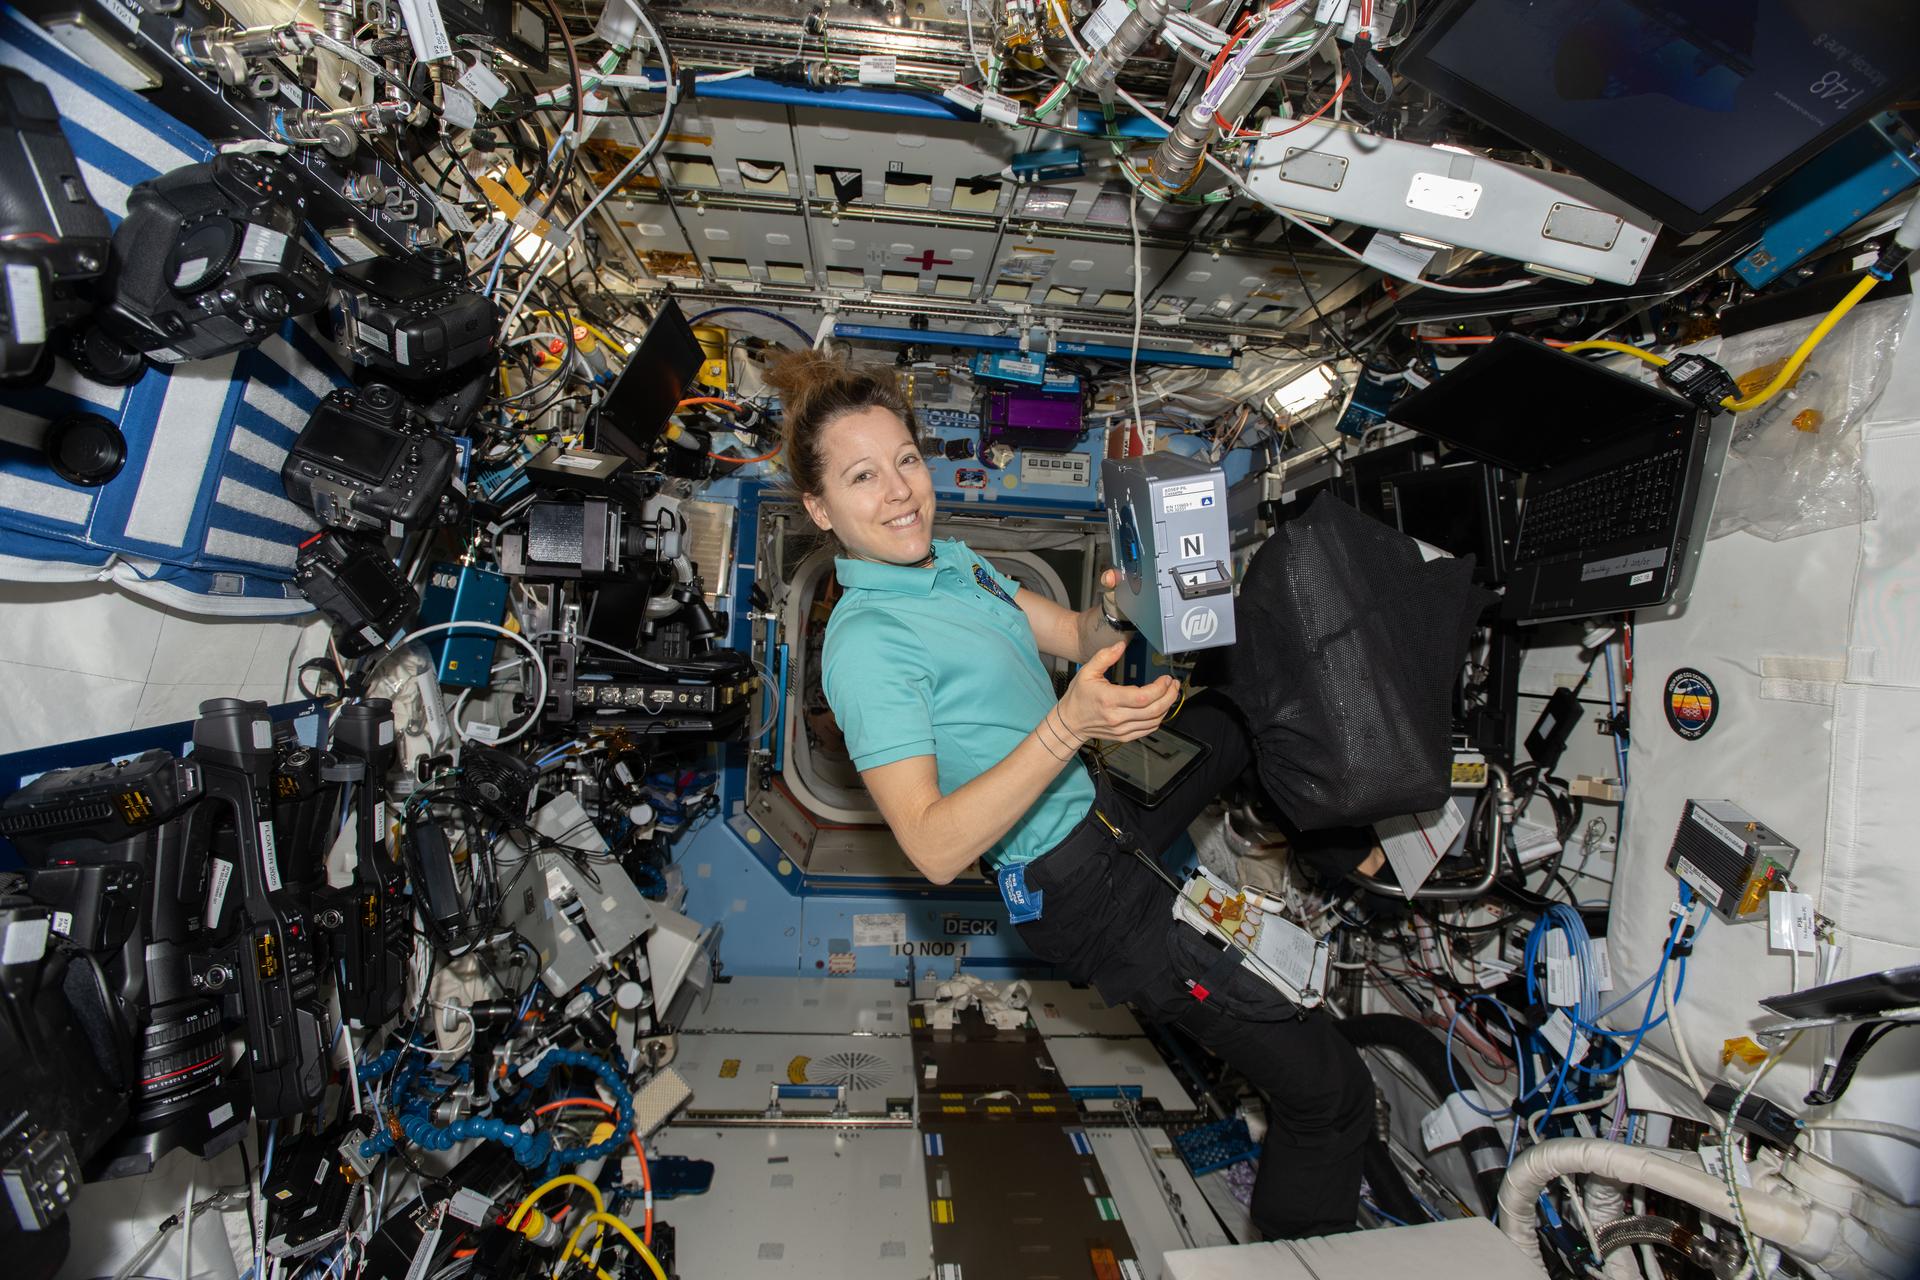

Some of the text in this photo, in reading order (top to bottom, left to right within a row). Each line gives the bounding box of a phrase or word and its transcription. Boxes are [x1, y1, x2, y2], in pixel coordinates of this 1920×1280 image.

[1809, 71, 1864, 110] 1:48
[314, 155, 327, 168] OFF
[396, 177, 421, 201] 120 VDC
[381, 212, 393, 224] OFF
[254, 229, 272, 260] Nikon
[928, 410, 980, 428] OVHD
[1184, 536, 1200, 557] N
[264, 824, 273, 869] FLOATER
[945, 919, 995, 935] DECK
[919, 942, 955, 956] NOD
[960, 942, 967, 956] 1
